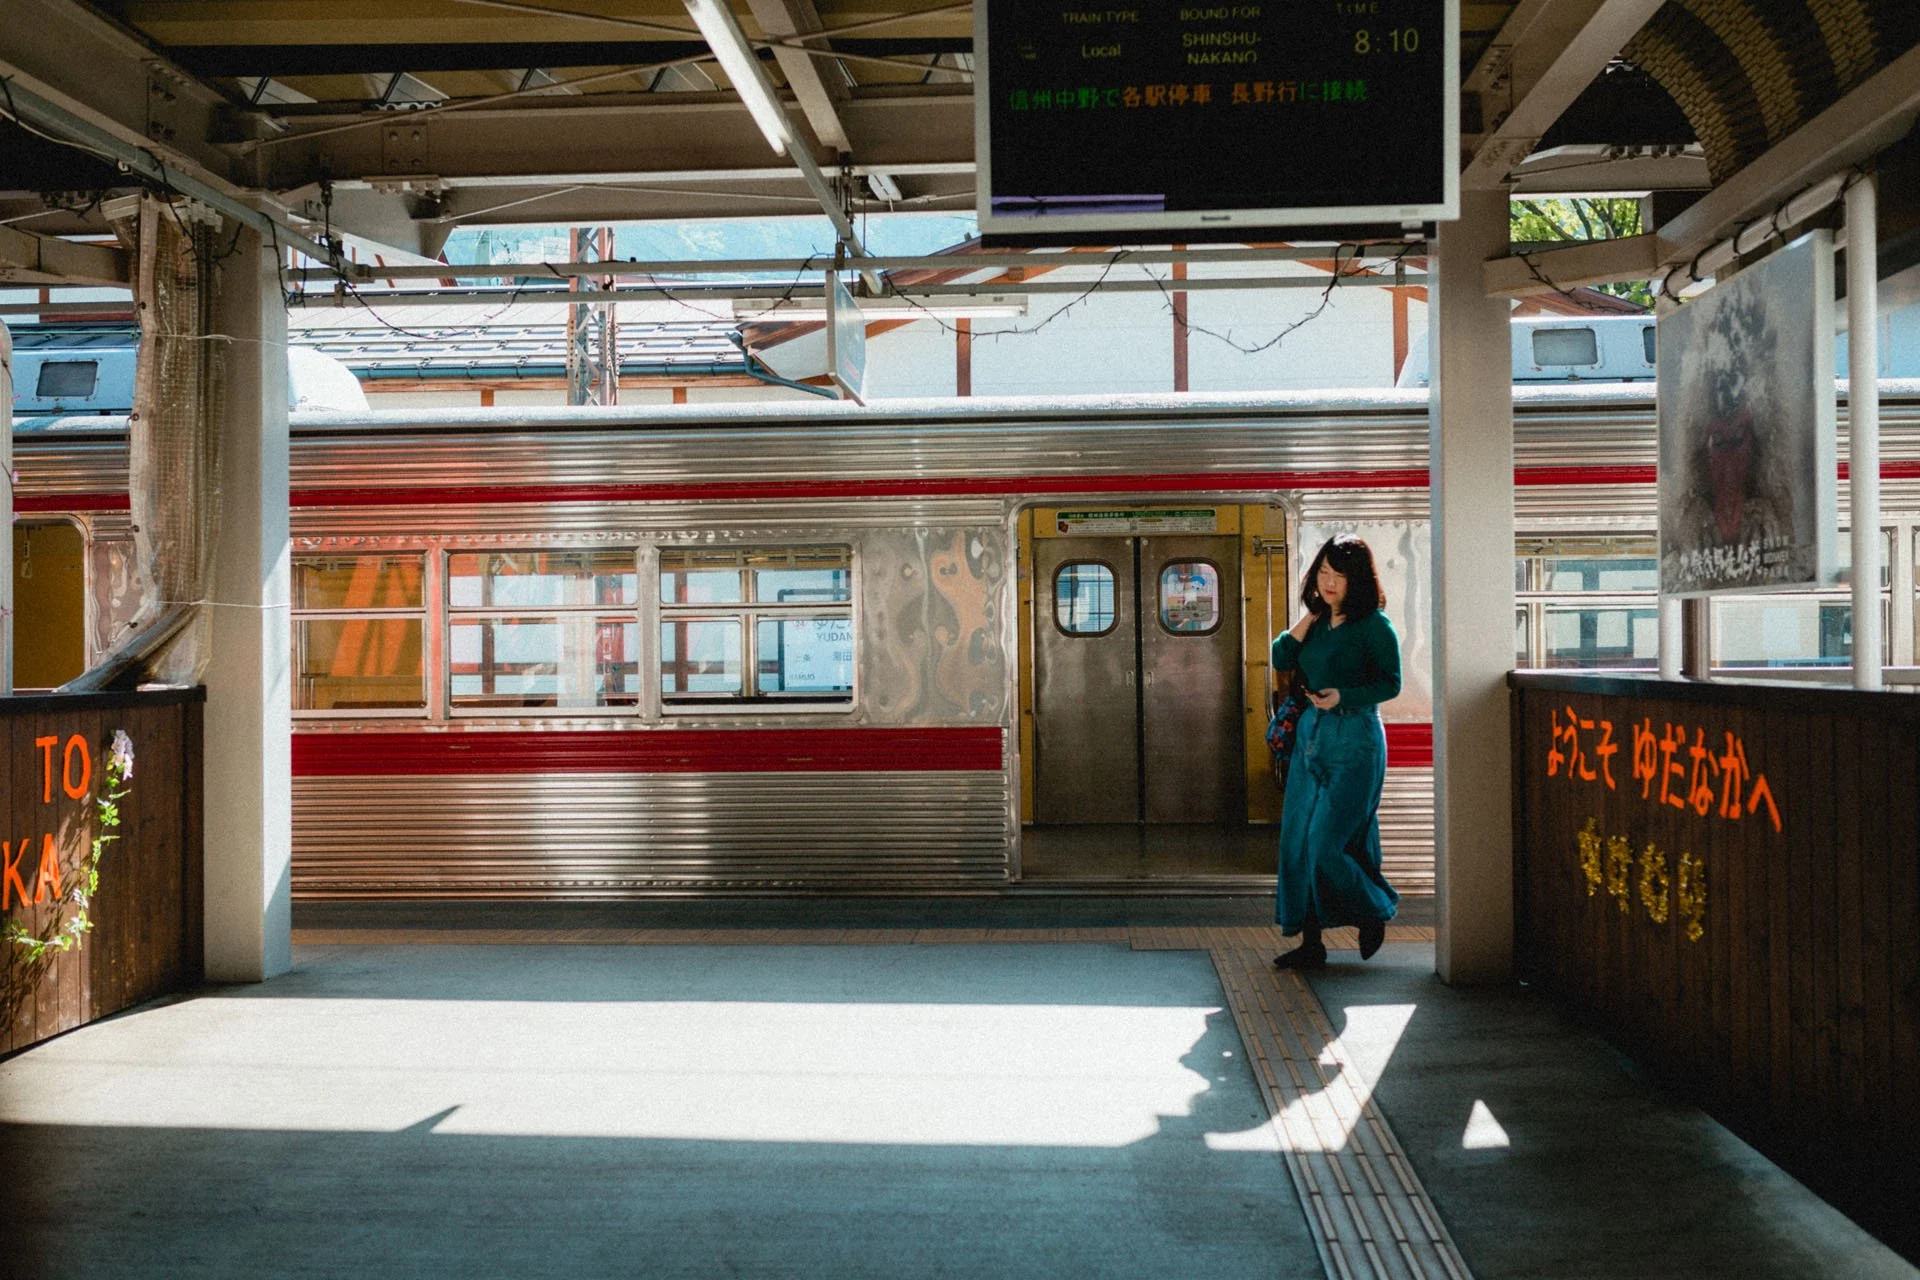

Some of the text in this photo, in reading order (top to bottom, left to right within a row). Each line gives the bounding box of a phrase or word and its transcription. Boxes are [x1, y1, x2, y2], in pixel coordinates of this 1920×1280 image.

[1062, 9, 1139, 25] TRAIN TYPE
[1180, 6, 1261, 21] BOUND FOR
[1182, 31, 1262, 48] SHINSHU-
[1354, 28, 1419, 55] 8:10
[1081, 43, 1121, 58] Local
[1186, 50, 1258, 66] NAKANO
[36, 734, 91, 803] TO
[1548, 705, 1782, 832] ようこそ ゆだなかへ
[2, 833, 63, 911] KA
